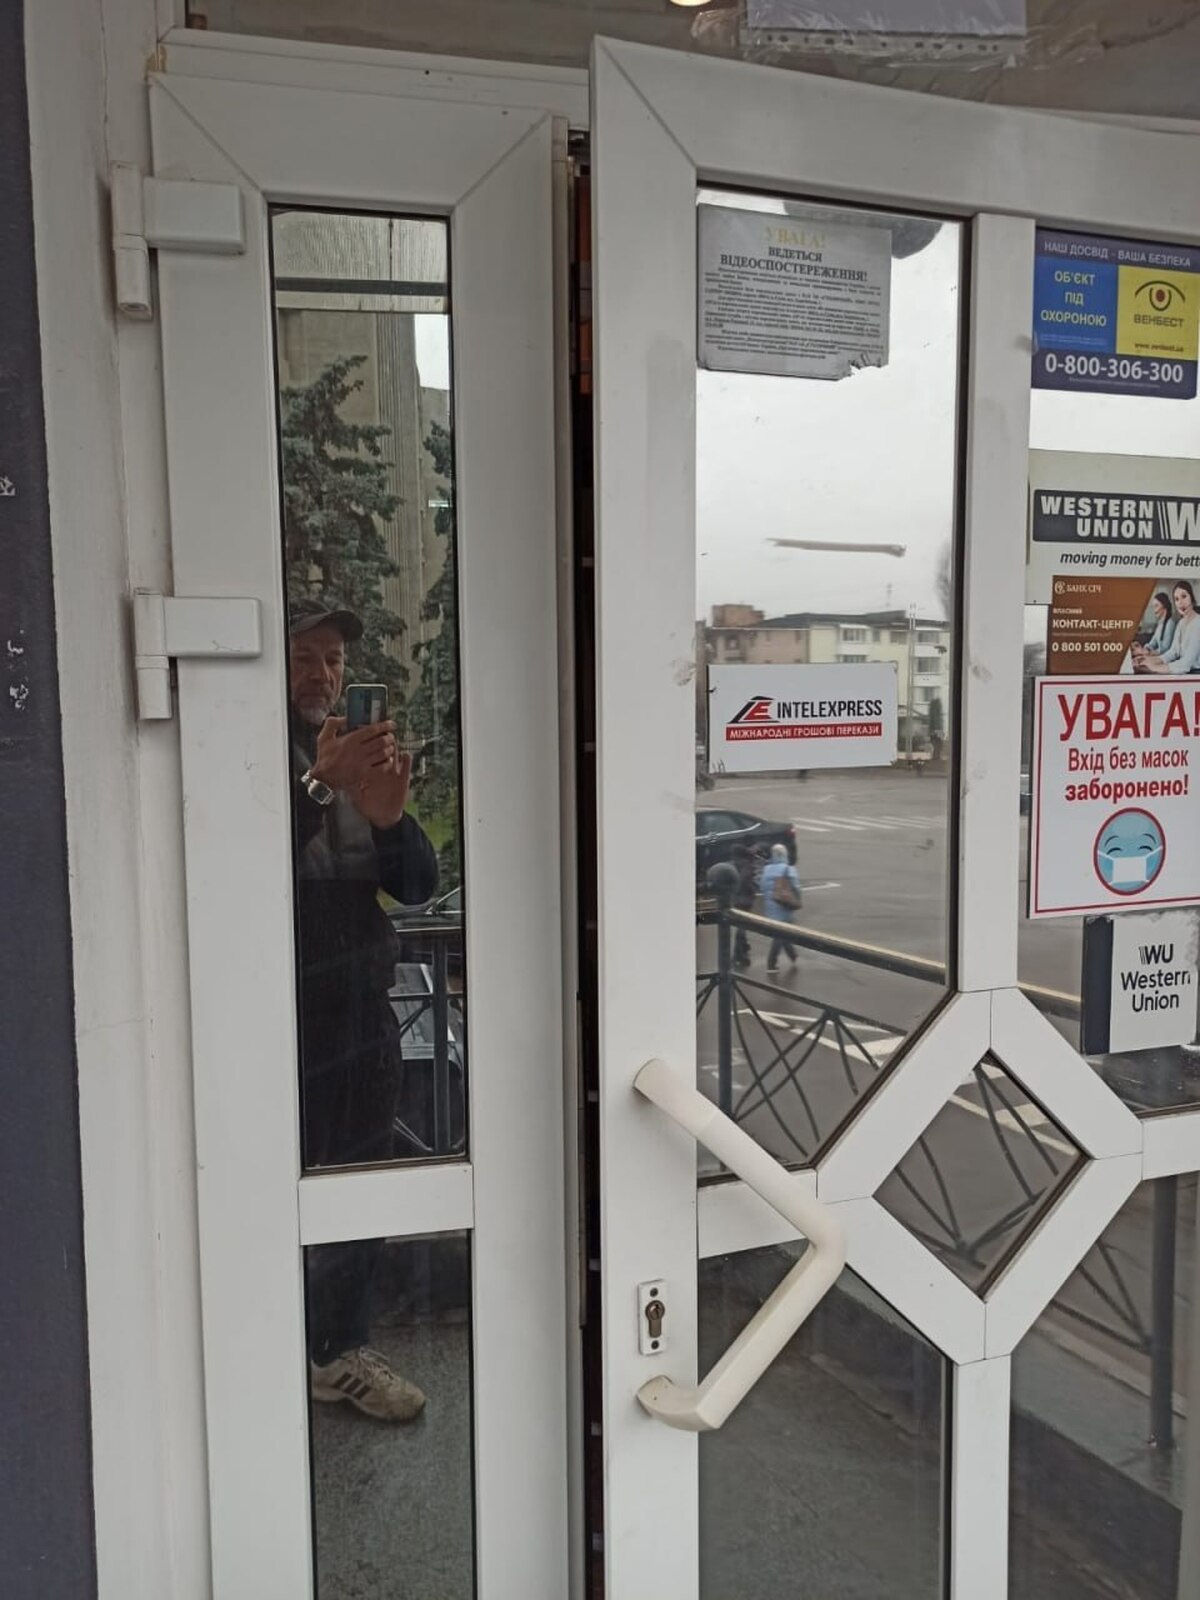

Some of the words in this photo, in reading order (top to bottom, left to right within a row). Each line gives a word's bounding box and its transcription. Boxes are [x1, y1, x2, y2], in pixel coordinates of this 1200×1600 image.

[765, 226, 826, 248] УВАГА!
[768, 246, 823, 262] ВЕДЕТЬСЯ
[1044, 241, 1068, 254] НАШ
[1069, 244, 1109, 260] ДОСВІД
[1118, 250, 1146, 262] ВАША
[1149, 254, 1191, 267] БЕЗПЕКА
[720, 254, 868, 282] ВІДЕОСПОСТЕРЕЖЕННЯ!
[1064, 291, 1085, 306] ПІД
[1040, 310, 1107, 327] ОХОРОНОЮ
[1133, 313, 1185, 328] ВЕНБЕСТ
[1045, 353, 1184, 383] 0-800-306-300
[1040, 495, 1154, 519] WESTERN
[1076, 518, 1154, 539] UNION
[1060, 551, 1107, 567] moving
[1110, 553, 1152, 568] money
[1155, 552, 1173, 566] for
[1175, 554, 1200, 567] bett
[1052, 619, 1134, 630] КОНТАКТ-ЦЕНТР
[1052, 642, 1059, 652] 0
[1061, 642, 1082, 652] 800
[1084, 642, 1100, 652] 501
[1103, 642, 1123, 652] 000
[777, 699, 883, 719] INTELEXPRESS
[1058, 691, 1200, 742] УВАГА!
[729, 726, 791, 740] МІЖНАРОДНІ
[793, 725, 834, 738] ГРОШОВІ
[836, 723, 880, 737] ПЕРЕКАЗИ
[1068, 747, 1105, 774] Вхід
[1110, 746, 1137, 770] без
[1141, 748, 1189, 769] масок
[1065, 774, 1189, 804] заборонено!
[1144, 943, 1174, 965] WU
[1131, 990, 1180, 1012] Union
